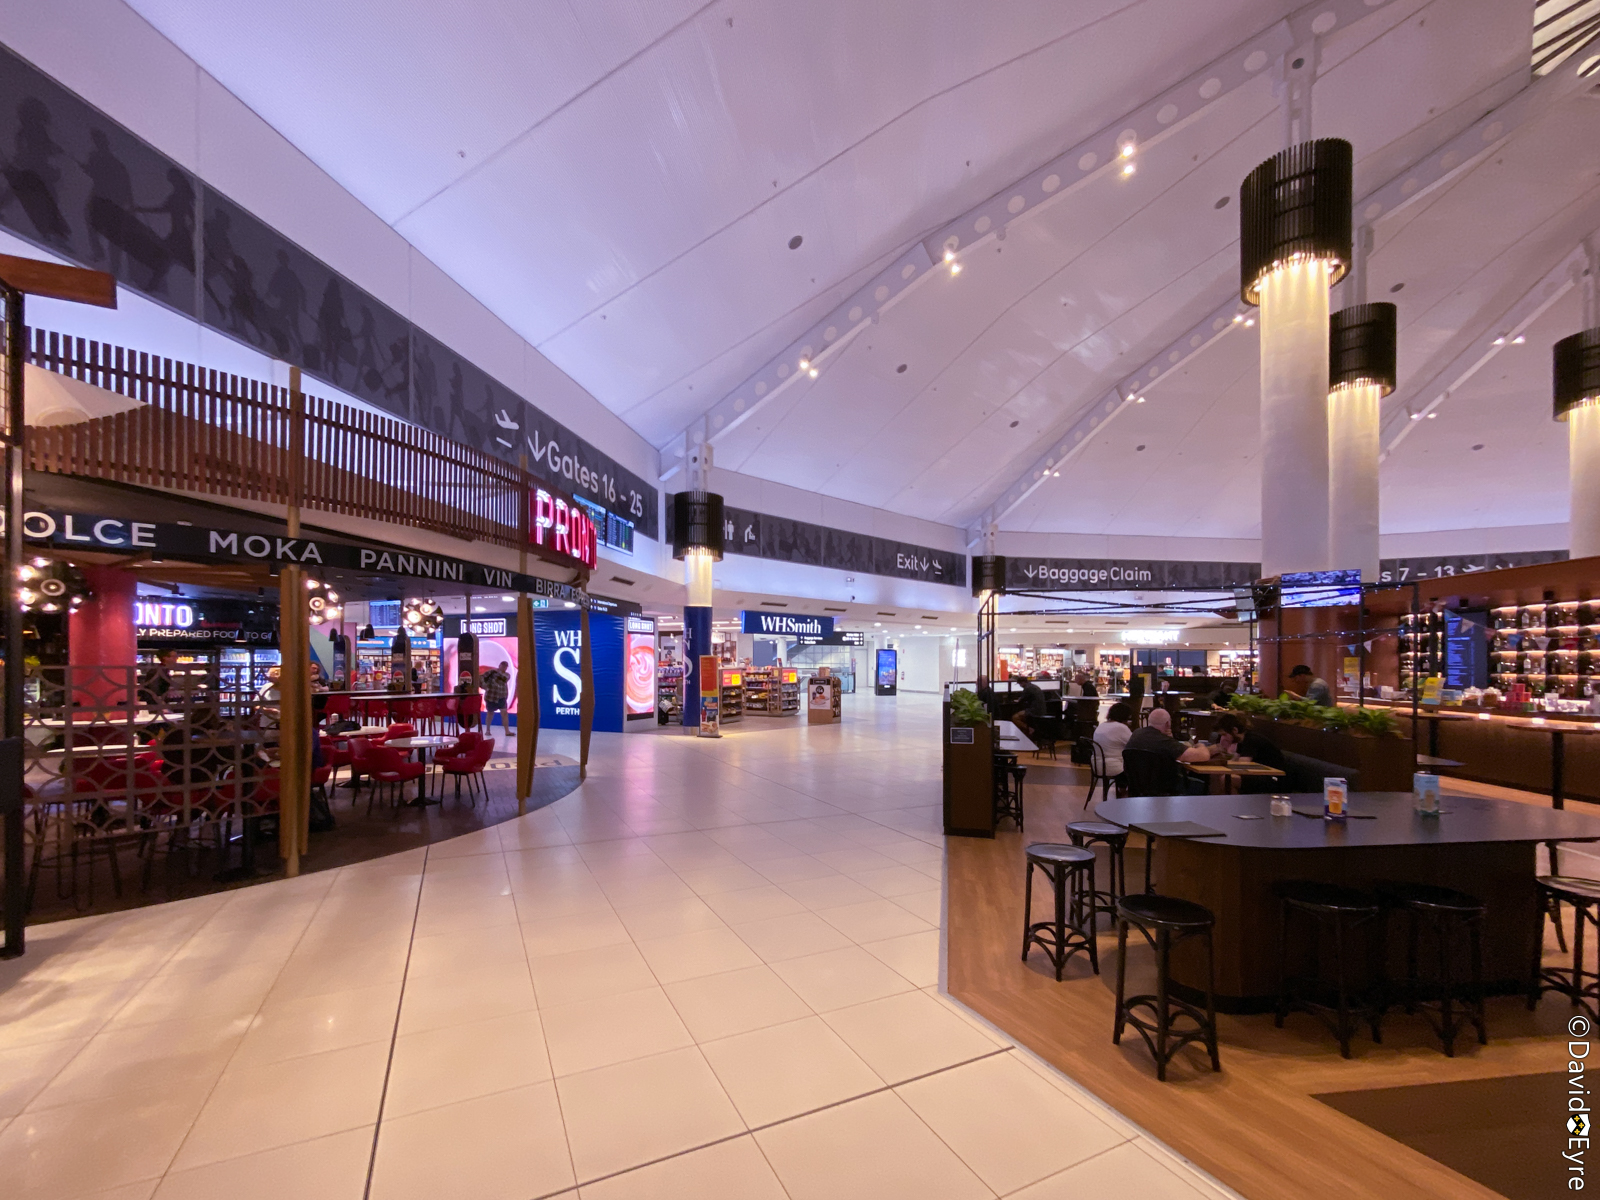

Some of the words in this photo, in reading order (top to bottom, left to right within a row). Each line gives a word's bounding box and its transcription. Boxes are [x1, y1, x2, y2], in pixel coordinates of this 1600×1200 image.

[547, 441, 599, 493] Gates
[602, 474, 616, 503] 16
[629, 489, 643, 517] 25
[0, 507, 156, 547] OLCE
[209, 530, 323, 564] MOKA
[360, 549, 464, 581] PANNINI
[483, 567, 513, 588] VIN
[535, 579, 566, 599] BIRRA
[897, 553, 919, 571] Exit
[1038, 565, 1108, 583] Baggage
[1110, 567, 1152, 581] Claim
[1399, 567, 1410, 581] 7
[1434, 565, 1455, 578] 13
[149, 628, 211, 638] PREPARED
[213, 630, 237, 639] FOO
[463, 622, 482, 633] LNG
[483, 620, 504, 633] SHOT
[760, 615, 822, 634] WHSmith
[554, 630, 581, 647] WH
[553, 647, 582, 706] S
[555, 706, 580, 716] PERTH
